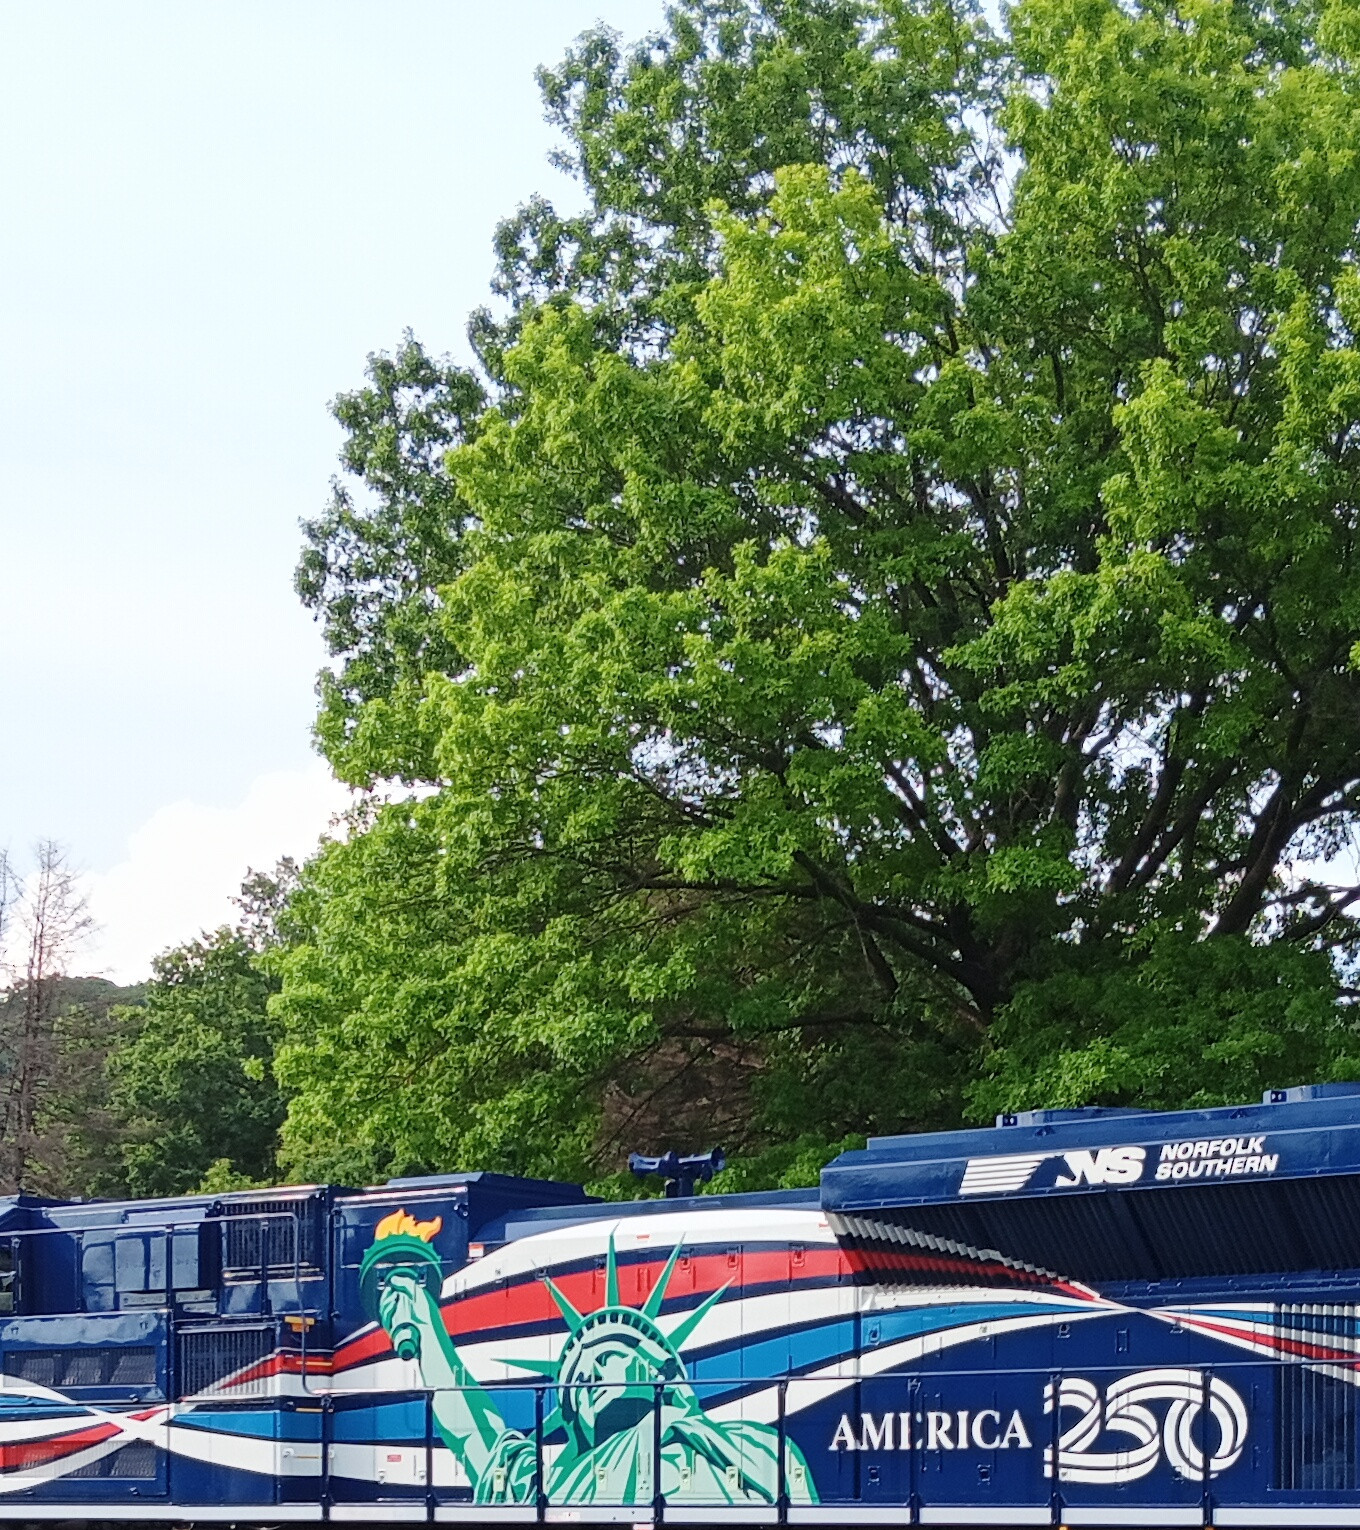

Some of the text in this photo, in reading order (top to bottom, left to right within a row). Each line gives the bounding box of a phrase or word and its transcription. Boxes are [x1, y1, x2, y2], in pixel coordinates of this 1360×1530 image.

[1160, 1136, 1266, 1161] NORFOLK
[1055, 1146, 1146, 1187] NS
[1155, 1154, 1279, 1180] SOUTHERN
[1043, 1369, 1248, 1484] 250
